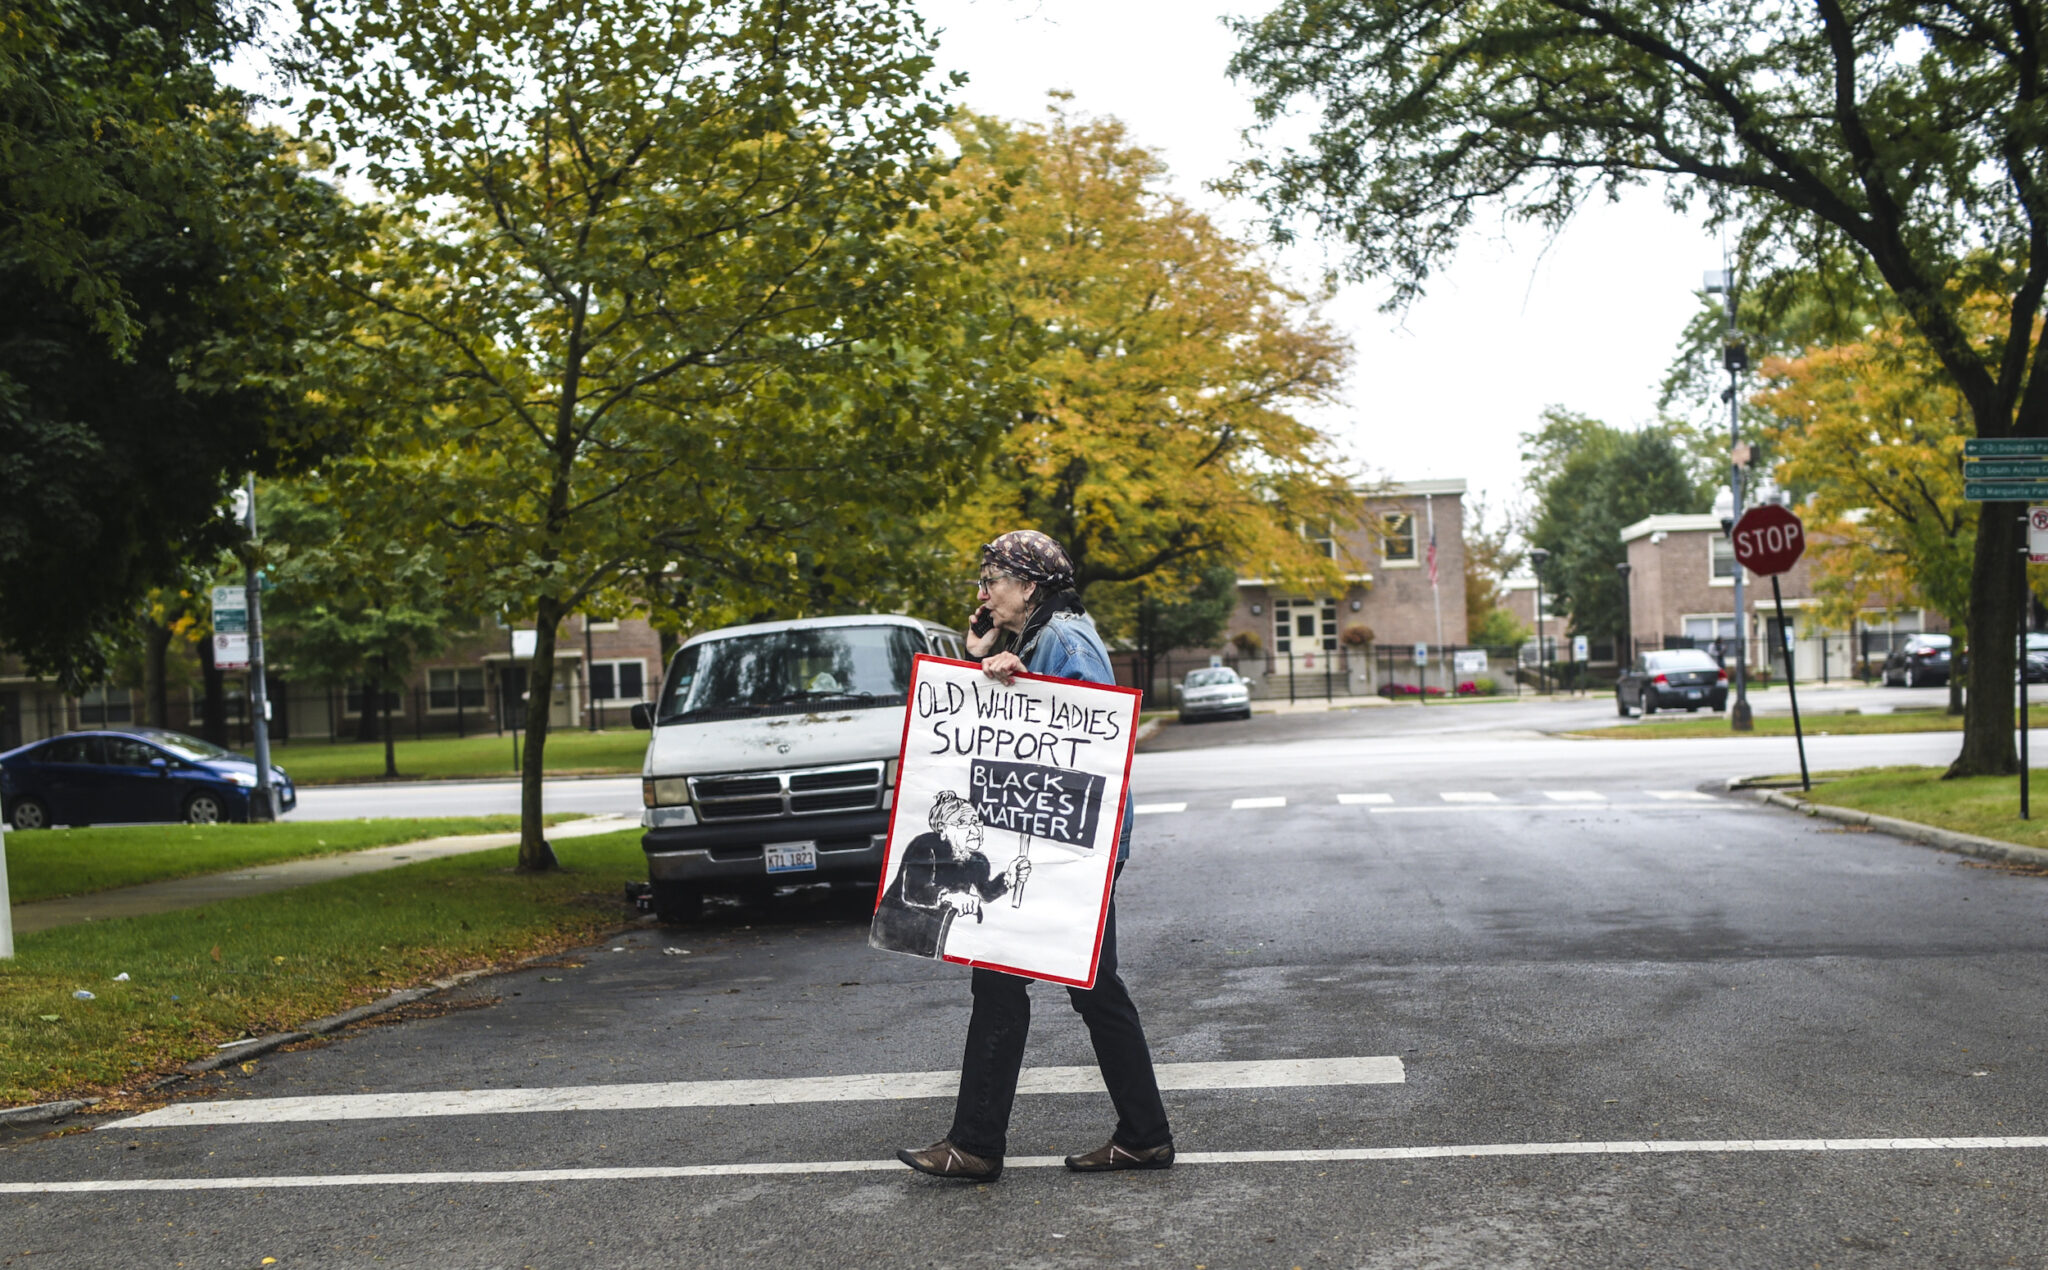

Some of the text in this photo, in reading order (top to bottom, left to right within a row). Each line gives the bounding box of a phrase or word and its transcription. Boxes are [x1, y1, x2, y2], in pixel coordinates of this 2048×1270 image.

[1737, 523, 1799, 558] STOP
[918, 681, 1120, 740] OLD WHITE LADIES
[930, 720, 1092, 768] SUPPORT
[973, 765, 1064, 793] BLACK
[982, 785, 1075, 816] LIVES
[768, 852, 813, 868] K71 1823
